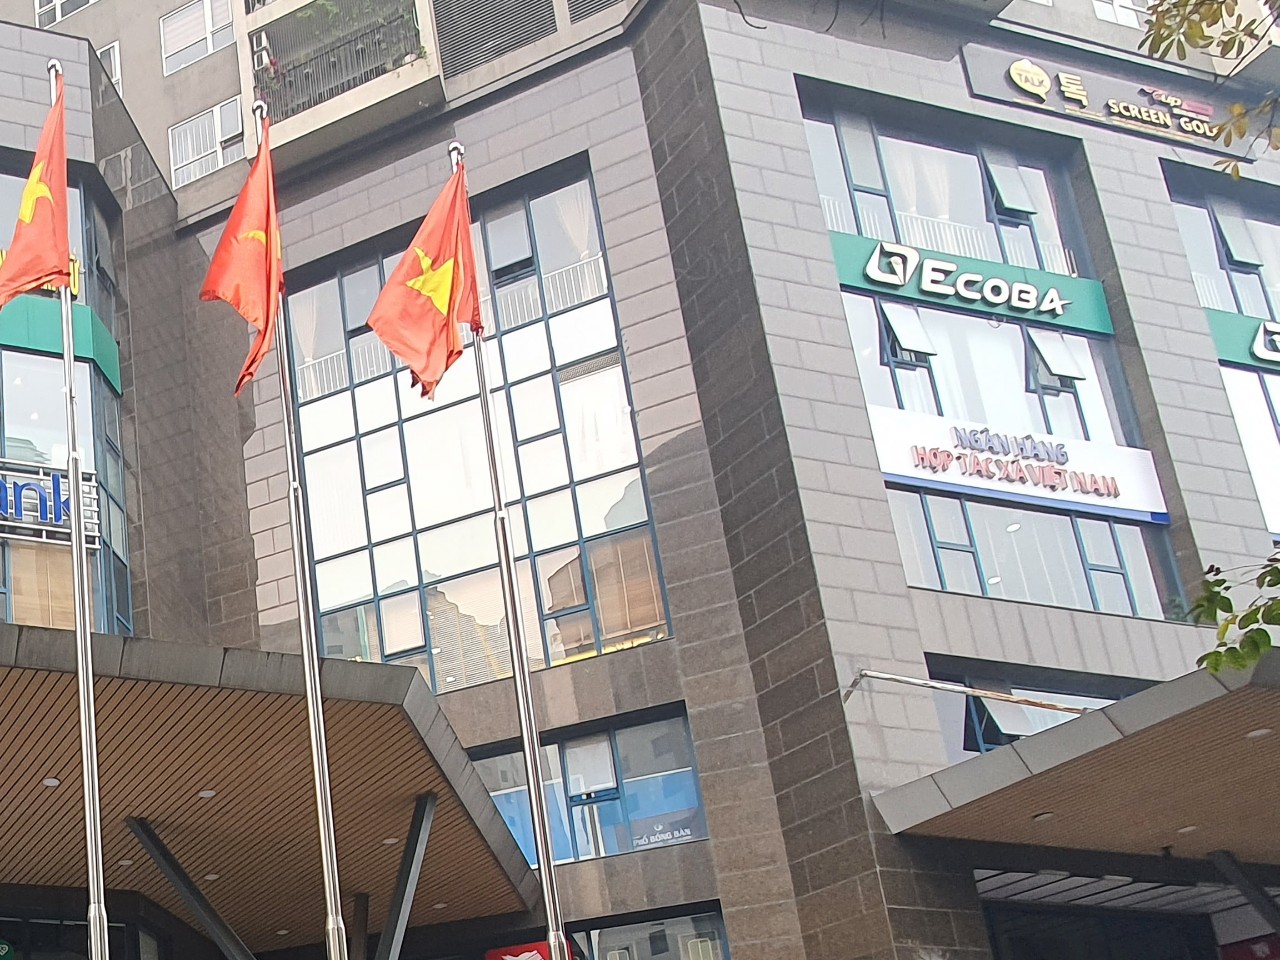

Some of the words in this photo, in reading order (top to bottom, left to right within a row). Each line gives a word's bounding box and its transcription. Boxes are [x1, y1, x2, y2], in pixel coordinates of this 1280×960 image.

[1107, 98, 1173, 127] SCREEN
[1179, 116, 1220, 138] GOL
[921, 258, 1072, 315] ECOBA
[1070, 471, 1120, 498] NAM
